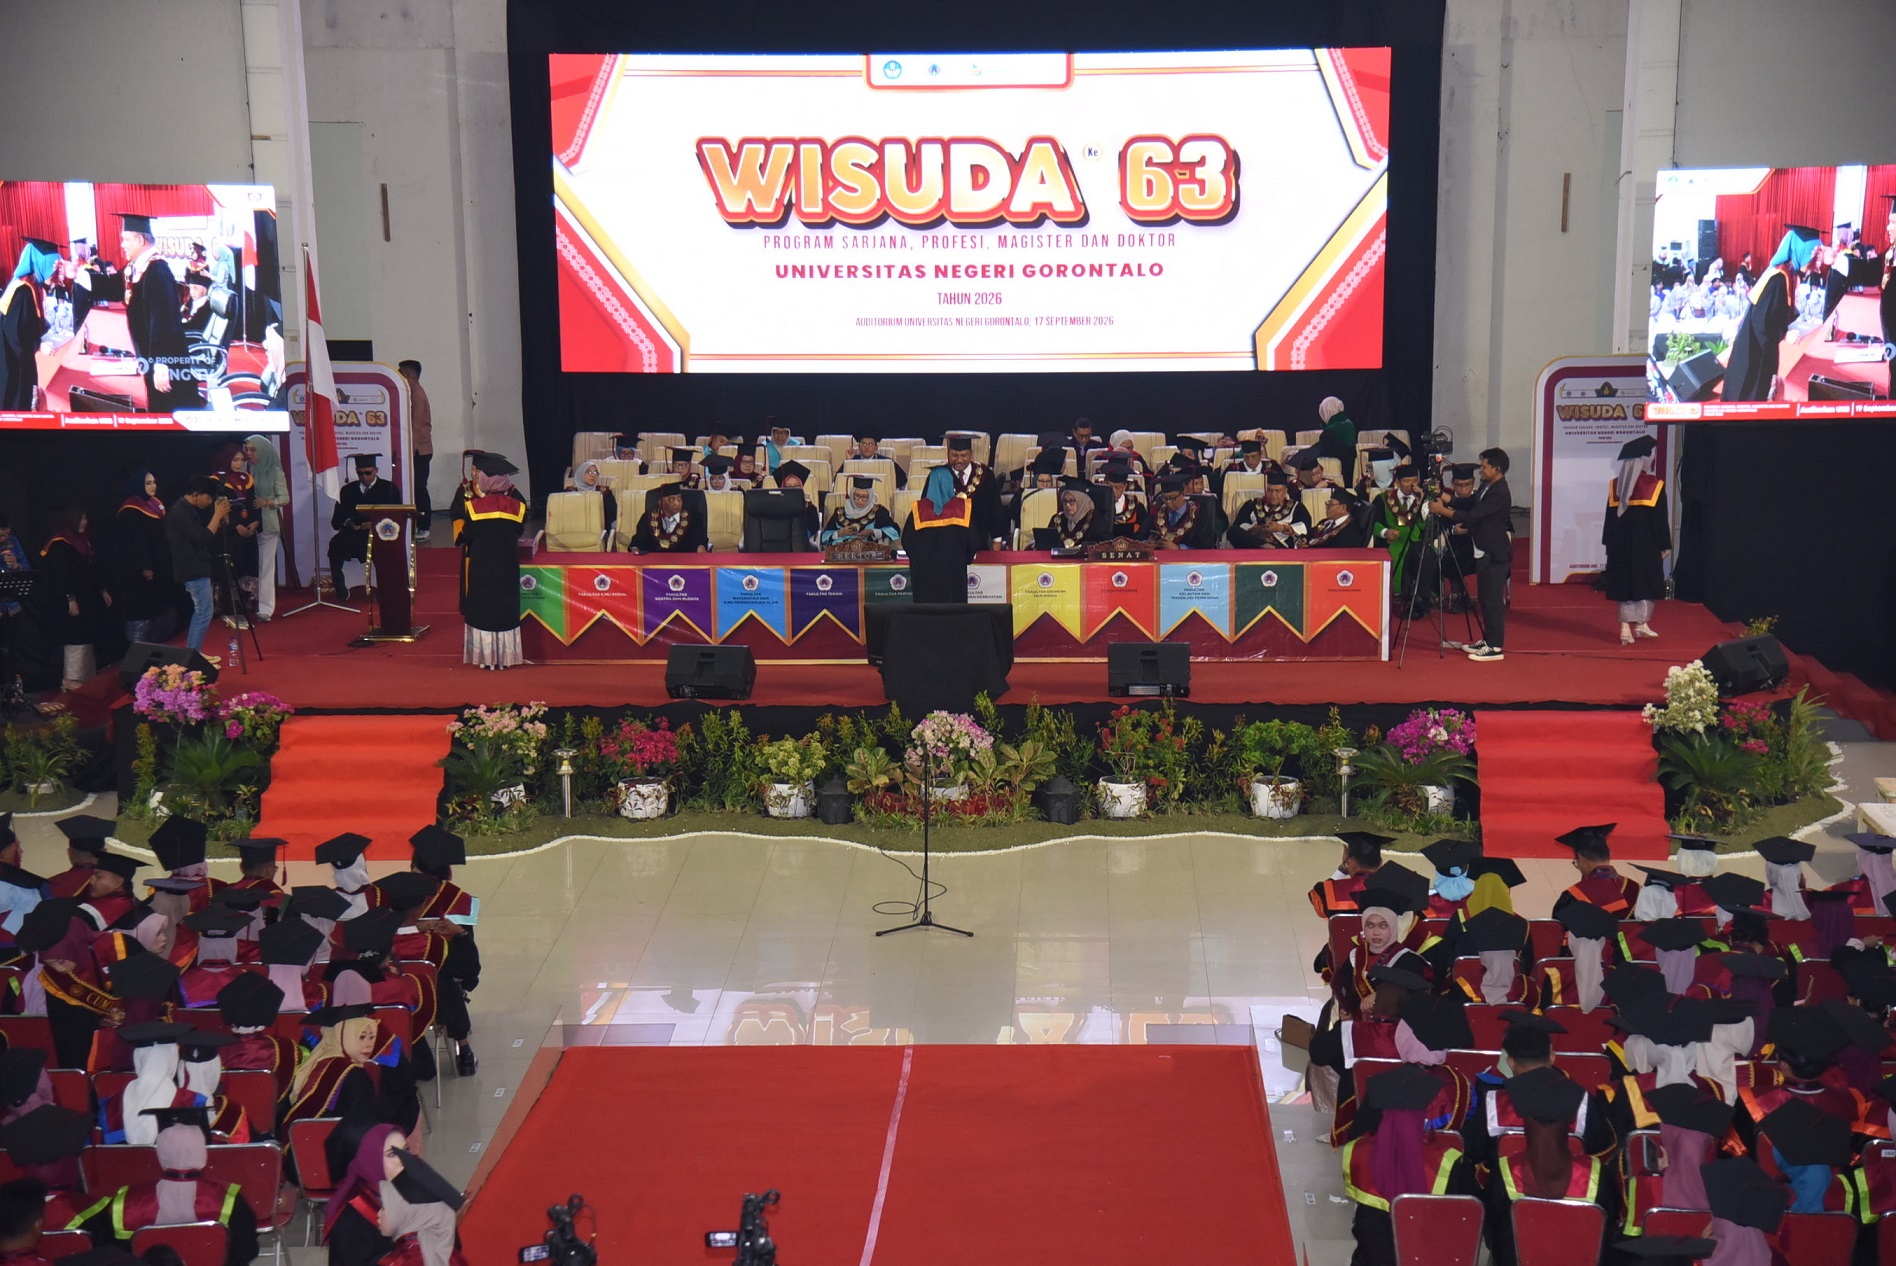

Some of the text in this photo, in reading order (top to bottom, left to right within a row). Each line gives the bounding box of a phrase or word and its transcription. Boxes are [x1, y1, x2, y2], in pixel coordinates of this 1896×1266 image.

[697, 137, 1085, 223] WISUDA
[1119, 135, 1237, 221] 63
[763, 232, 1176, 250] PROGRAM SARJANA, PROFESI, MAGISTER DAN DOKTOR
[775, 262, 1164, 279] UNIVERSITAS NEGERI GORONTALO
[937, 291, 1003, 305] TAHUN 2026
[855, 317, 903, 327] AUDITORIUM
[904, 317, 953, 327] UNIVERSITAS
[955, 316, 983, 326] NEGERI
[1034, 316, 1044, 326] 17
[1045, 315, 1092, 326] SEPTEMBER
[1093, 315, 1114, 326] 2026
[366, 410, 388, 427] 63
[1557, 404, 1627, 421] WISUDA
[1101, 551, 1141, 559] SENAT
